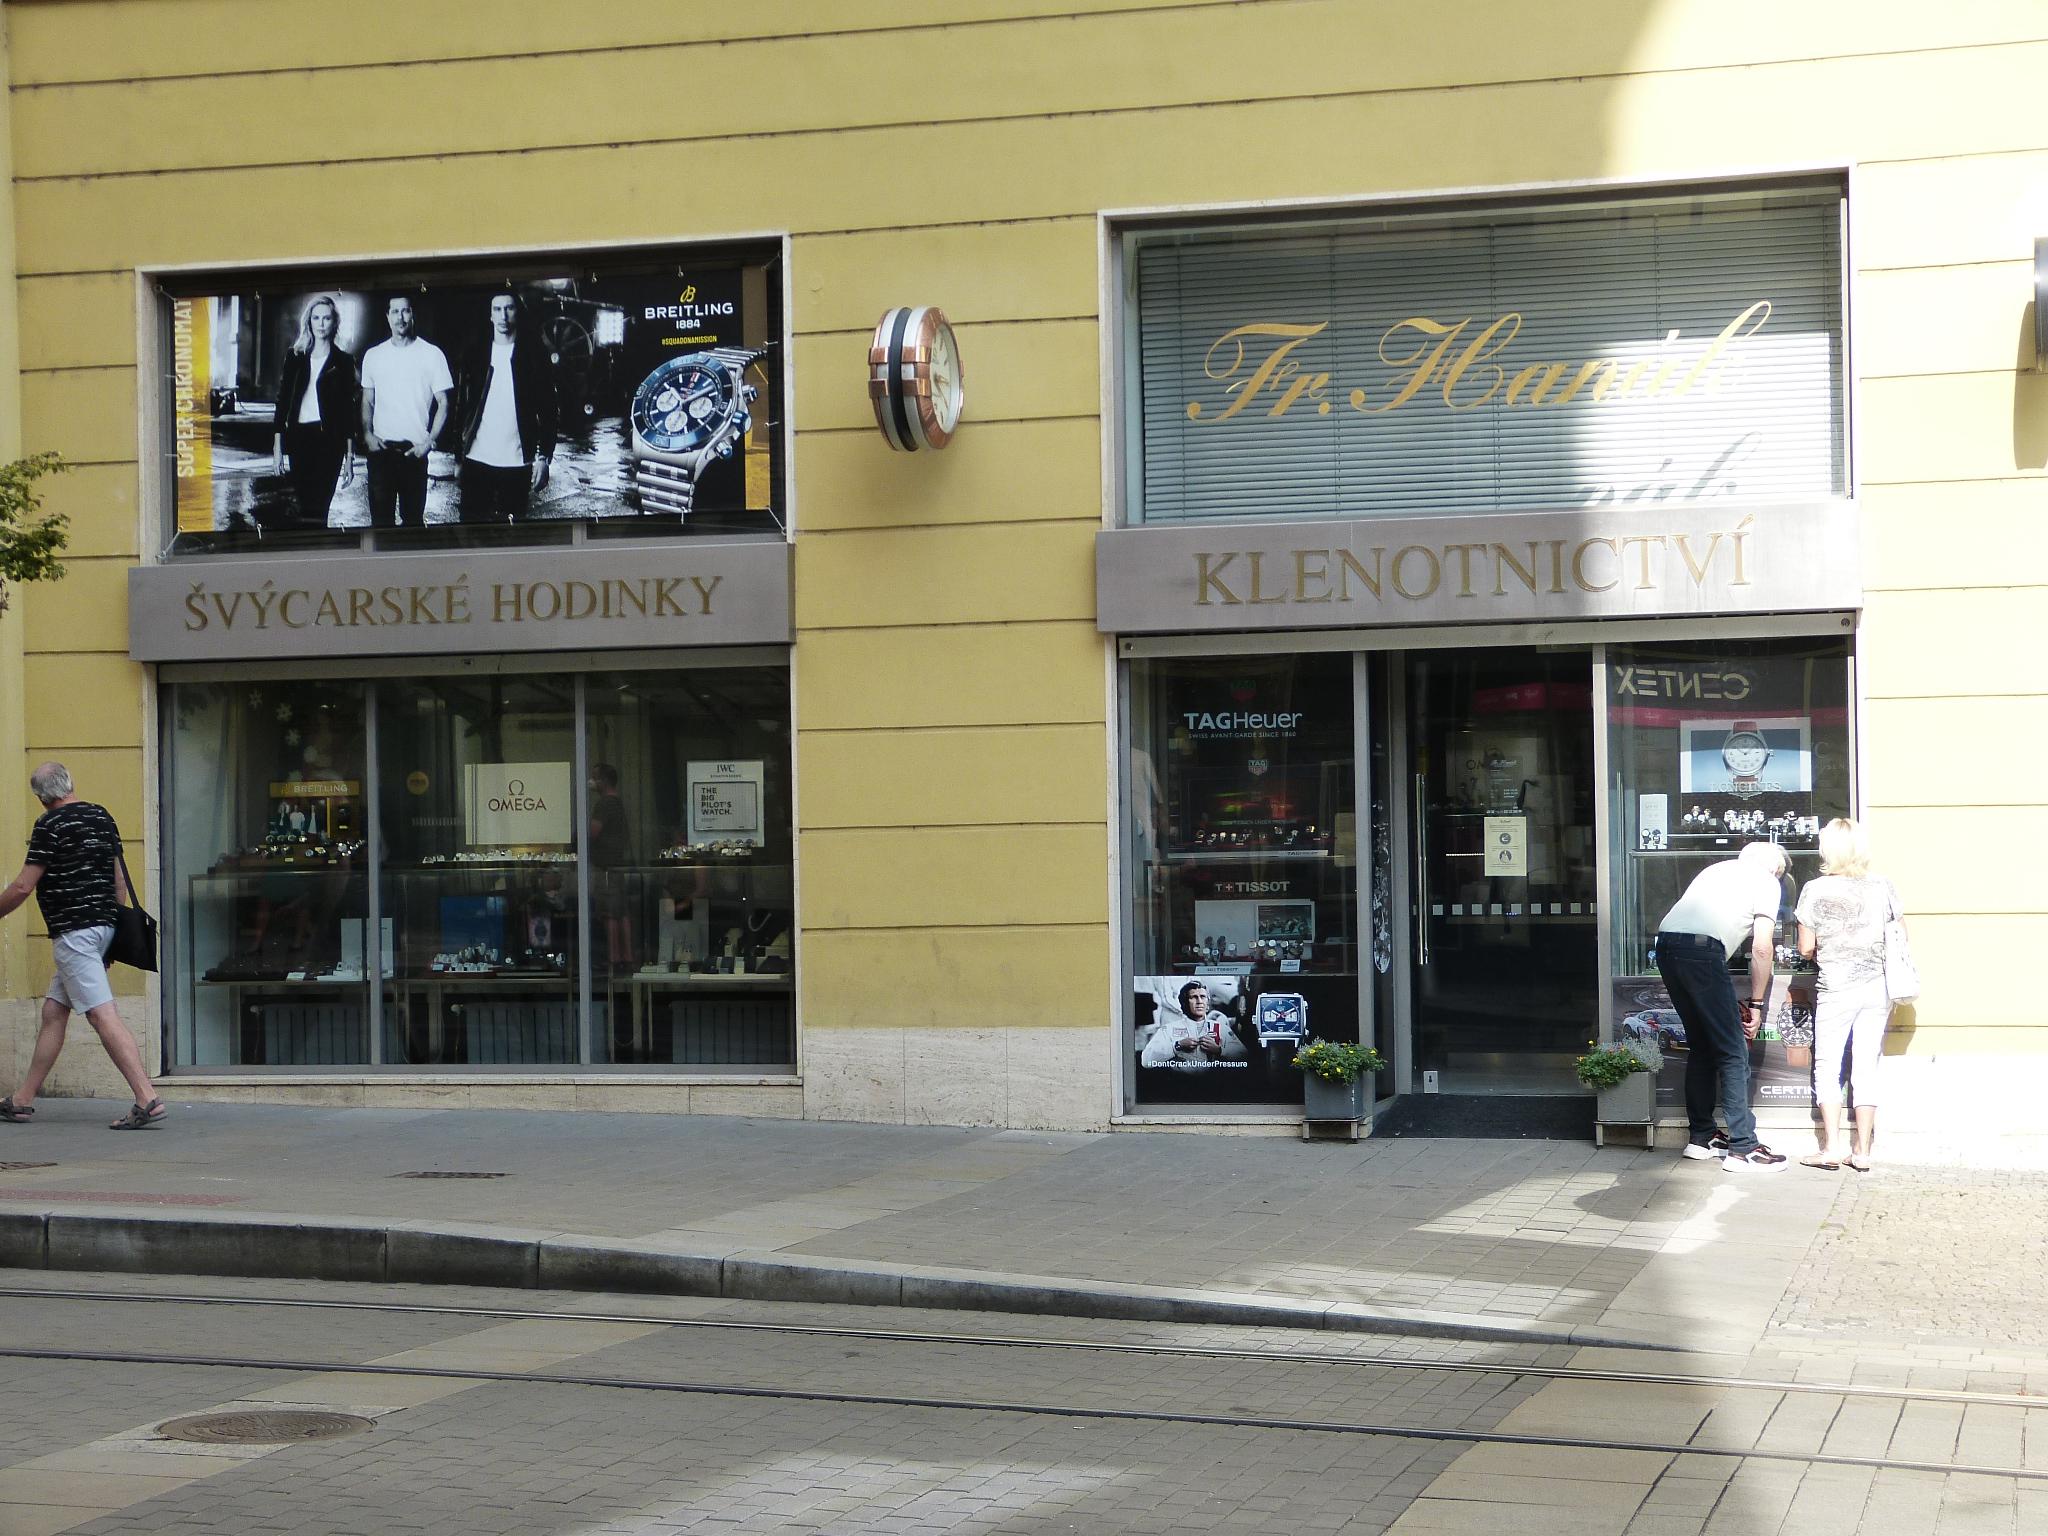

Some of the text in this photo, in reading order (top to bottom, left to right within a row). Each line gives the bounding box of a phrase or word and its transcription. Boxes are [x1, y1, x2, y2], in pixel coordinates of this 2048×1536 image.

[644, 302, 734, 320] BREITLING
[675, 318, 701, 329] 1884
[661, 335, 718, 346] #SQUADONAMISSION
[1187, 321, 1330, 422] Fr.
[174, 299, 194, 478] SUPER CHRONOMAT
[1195, 513, 1754, 605] KLENOTNICTVÍ
[184, 572, 724, 632] ŠVÝCARSKÉ HODINKY
[717, 764, 736, 773] IWC
[294, 783, 349, 794] BREITLING
[488, 797, 547, 812] OMEGA
[701, 801, 732, 809] PILOT'S
[1763, 1030, 1775, 1040] ME
[1147, 1060, 1248, 1070] #DontCrackUnderPressure
[1760, 1085, 1817, 1095] CERTIN
